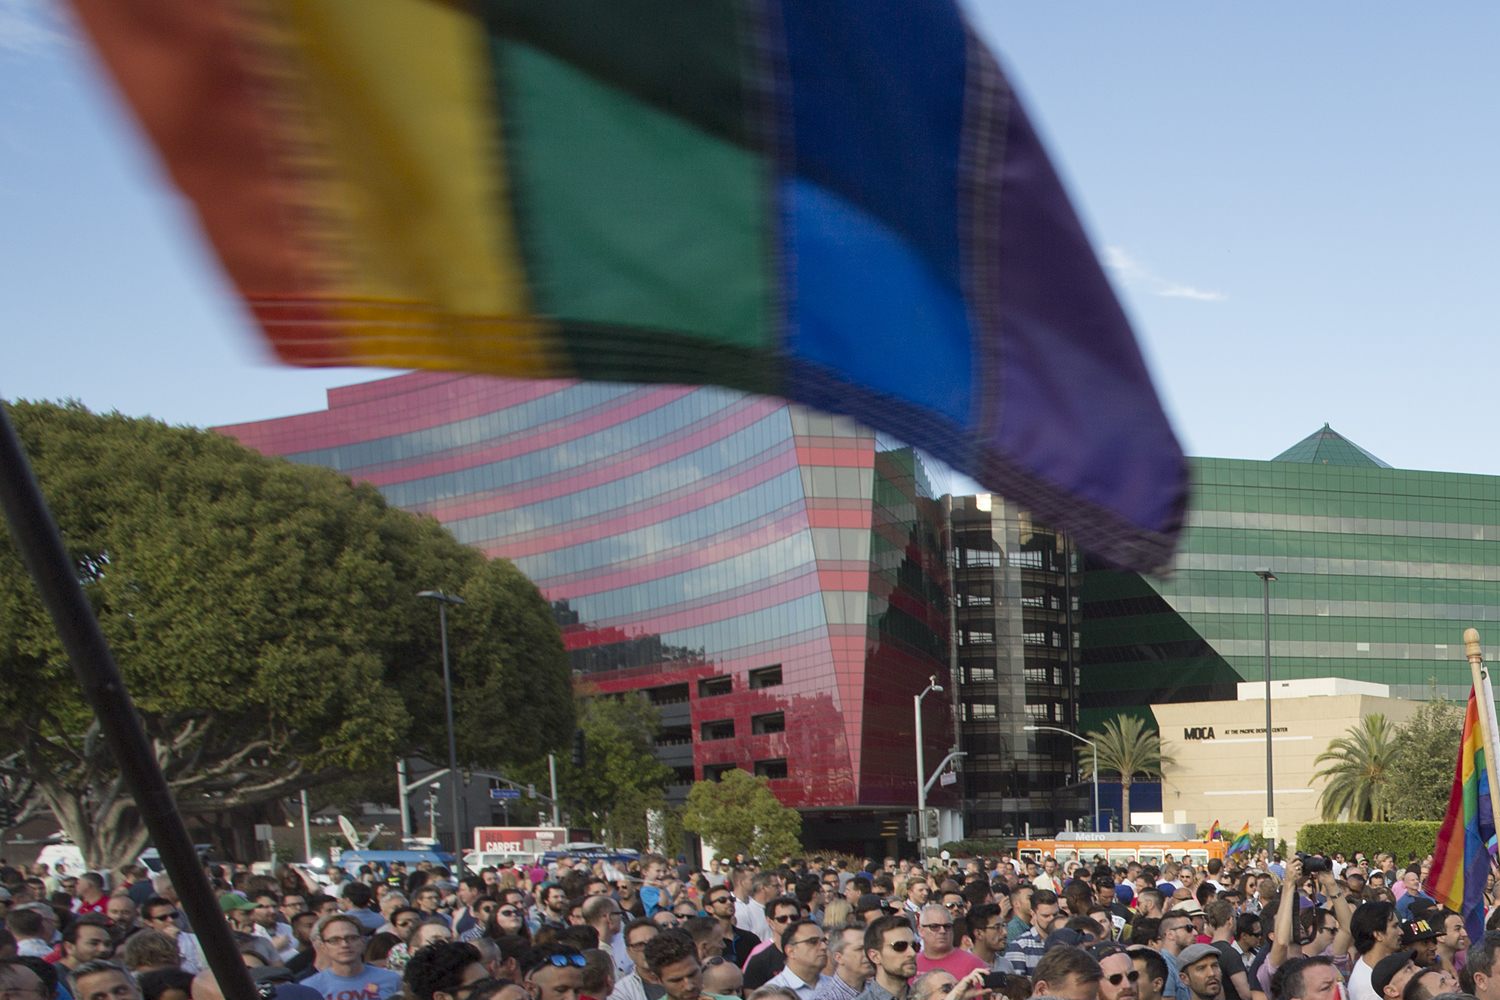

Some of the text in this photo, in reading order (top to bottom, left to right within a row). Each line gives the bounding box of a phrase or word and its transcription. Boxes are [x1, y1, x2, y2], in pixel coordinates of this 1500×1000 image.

[1184, 727, 1215, 740] MOCA
[485, 832, 503, 842] RED
[1075, 832, 1106, 841] Metro
[486, 842, 521, 852] CARPET
